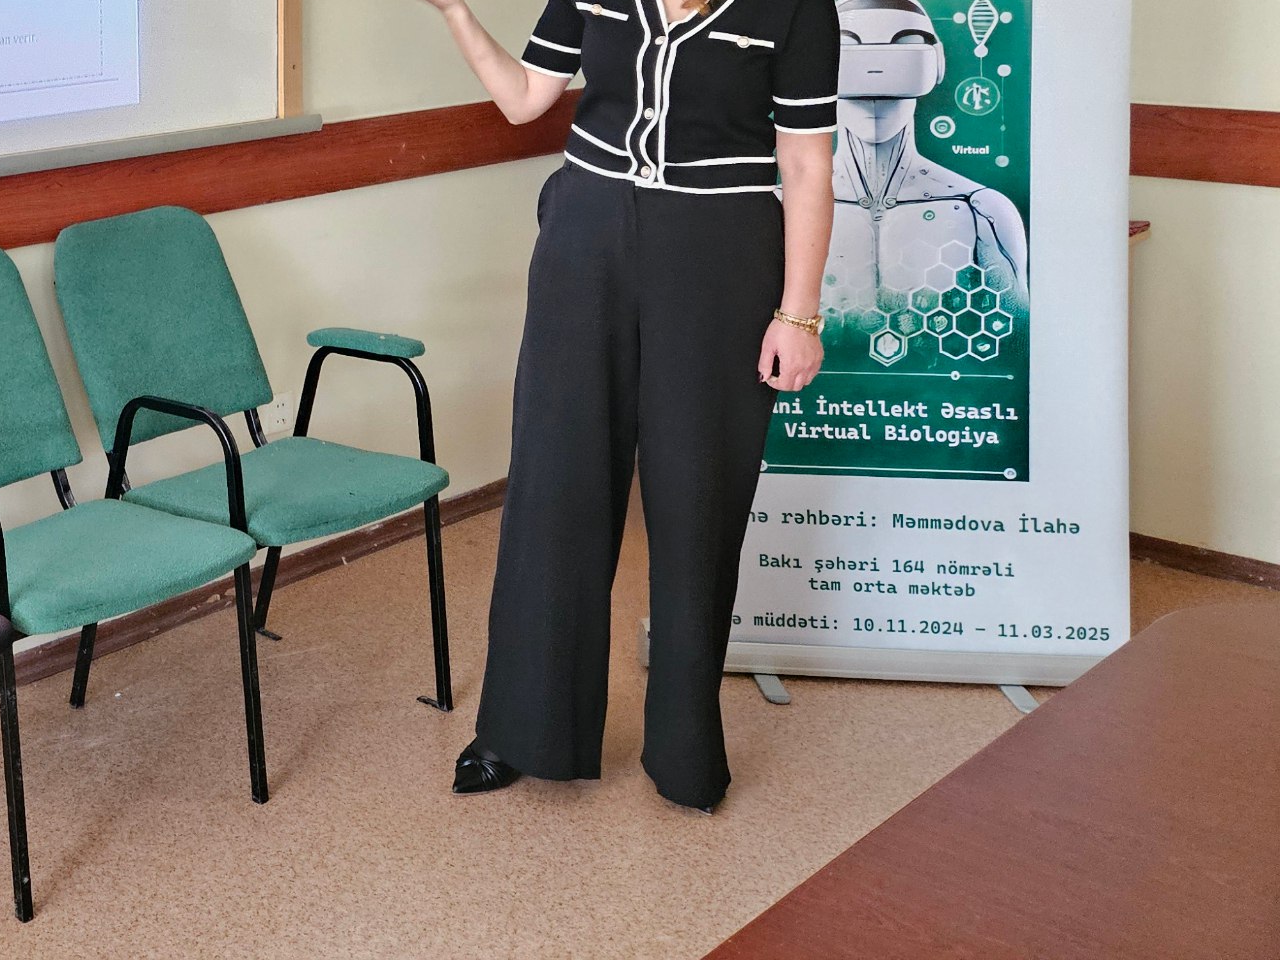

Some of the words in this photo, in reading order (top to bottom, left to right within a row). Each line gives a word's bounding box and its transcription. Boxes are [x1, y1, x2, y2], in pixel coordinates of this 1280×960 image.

[951, 145, 990, 155] Virtual
[816, 395, 928, 418] İntellekt
[940, 402, 1018, 421] Əsaslı
[784, 422, 871, 440] Virtual
[884, 424, 1000, 447] Biologiya
[781, 509, 876, 527] rəhbəri:
[892, 513, 1006, 532] Məmmədova
[1018, 513, 1081, 534] İlahə
[759, 554, 802, 569] Bakı
[814, 557, 880, 573] şəhəri
[892, 559, 925, 573] 164
[936, 560, 1015, 577] nömrəli
[808, 578, 841, 591] tam
[853, 580, 898, 594] orta
[908, 581, 976, 597] məktəb
[753, 612, 838, 630] müddəti:
[853, 617, 964, 636] 10.11.2024
[997, 624, 1110, 642] 11.03.2025
